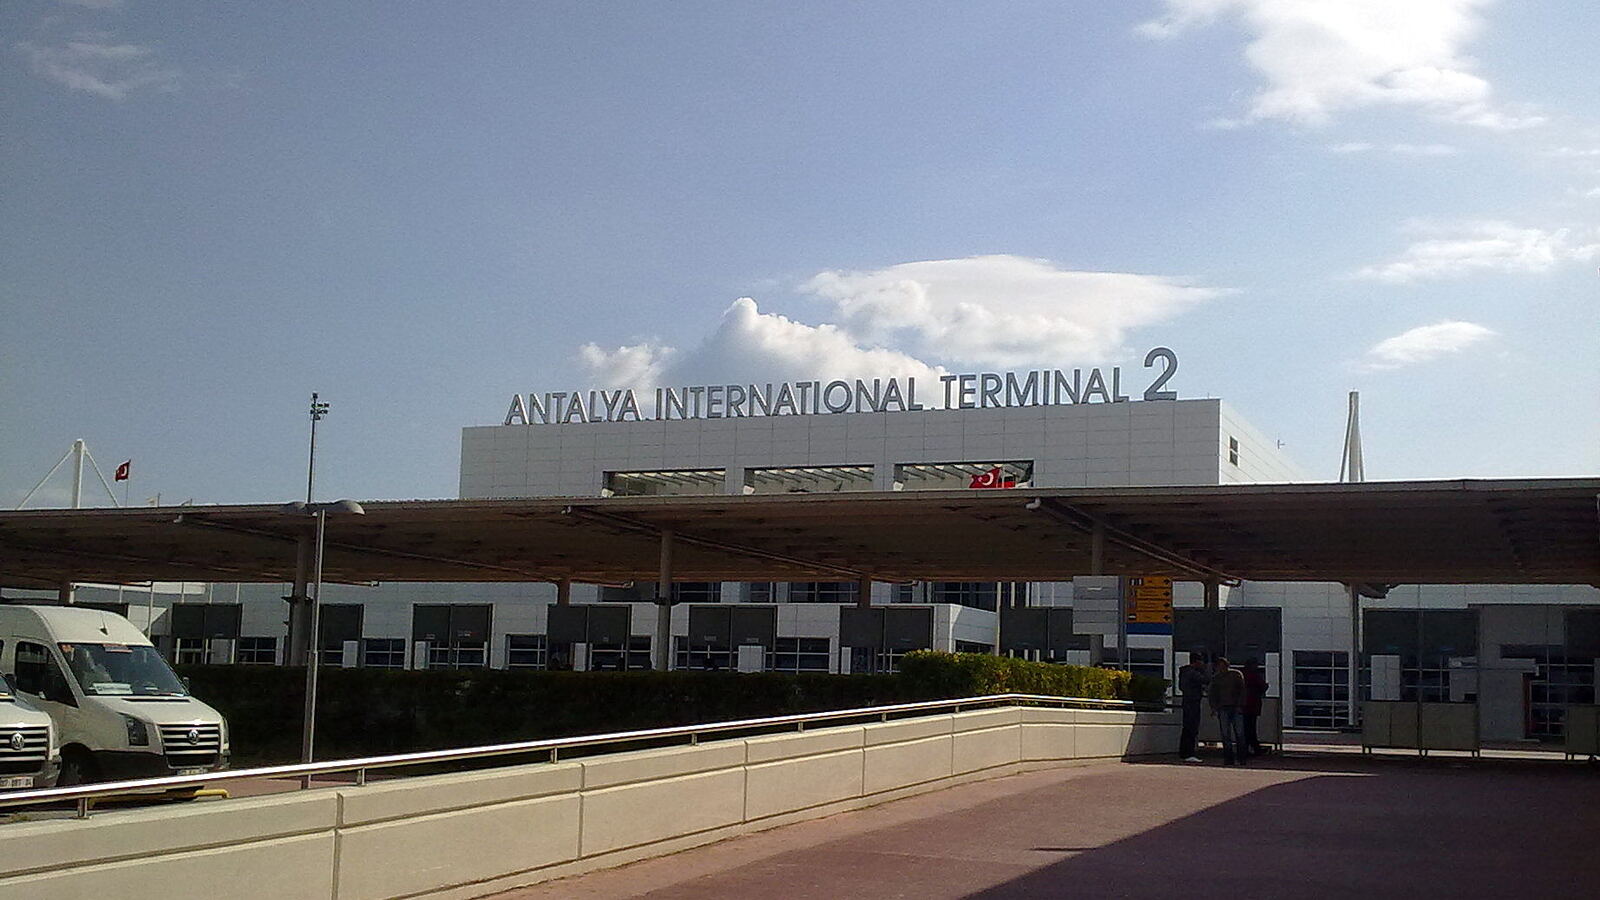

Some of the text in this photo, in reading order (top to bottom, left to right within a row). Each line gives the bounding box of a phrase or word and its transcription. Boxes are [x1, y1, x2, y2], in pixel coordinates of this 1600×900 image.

[504, 346, 1179, 425] ANTALYA INTERNATIONAL TERMINAL 2
